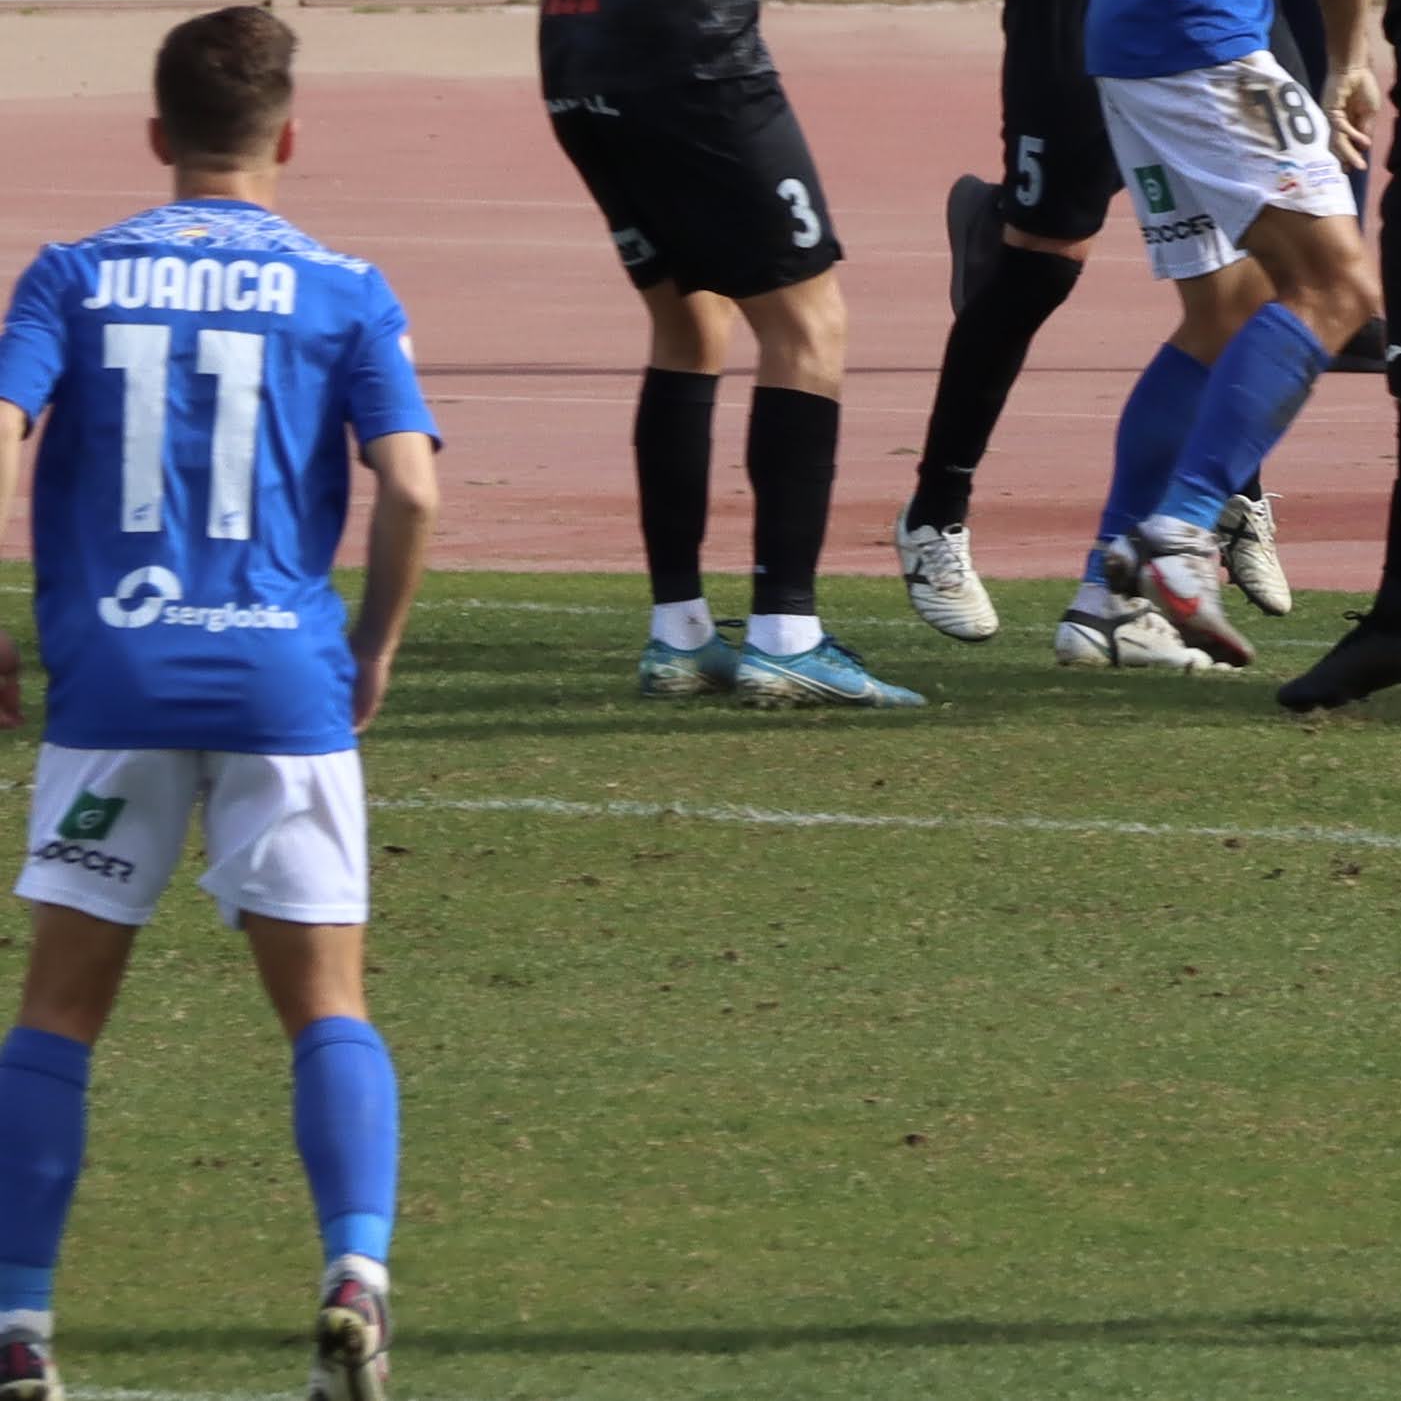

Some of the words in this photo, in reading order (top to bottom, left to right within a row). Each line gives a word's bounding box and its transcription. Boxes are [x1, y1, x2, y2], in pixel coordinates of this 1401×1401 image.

[1246, 81, 1317, 152] 18
[1015, 135, 1046, 208] 5
[776, 177, 822, 249] 3
[83, 257, 297, 315] JUANCA
[103, 323, 266, 541] 11
